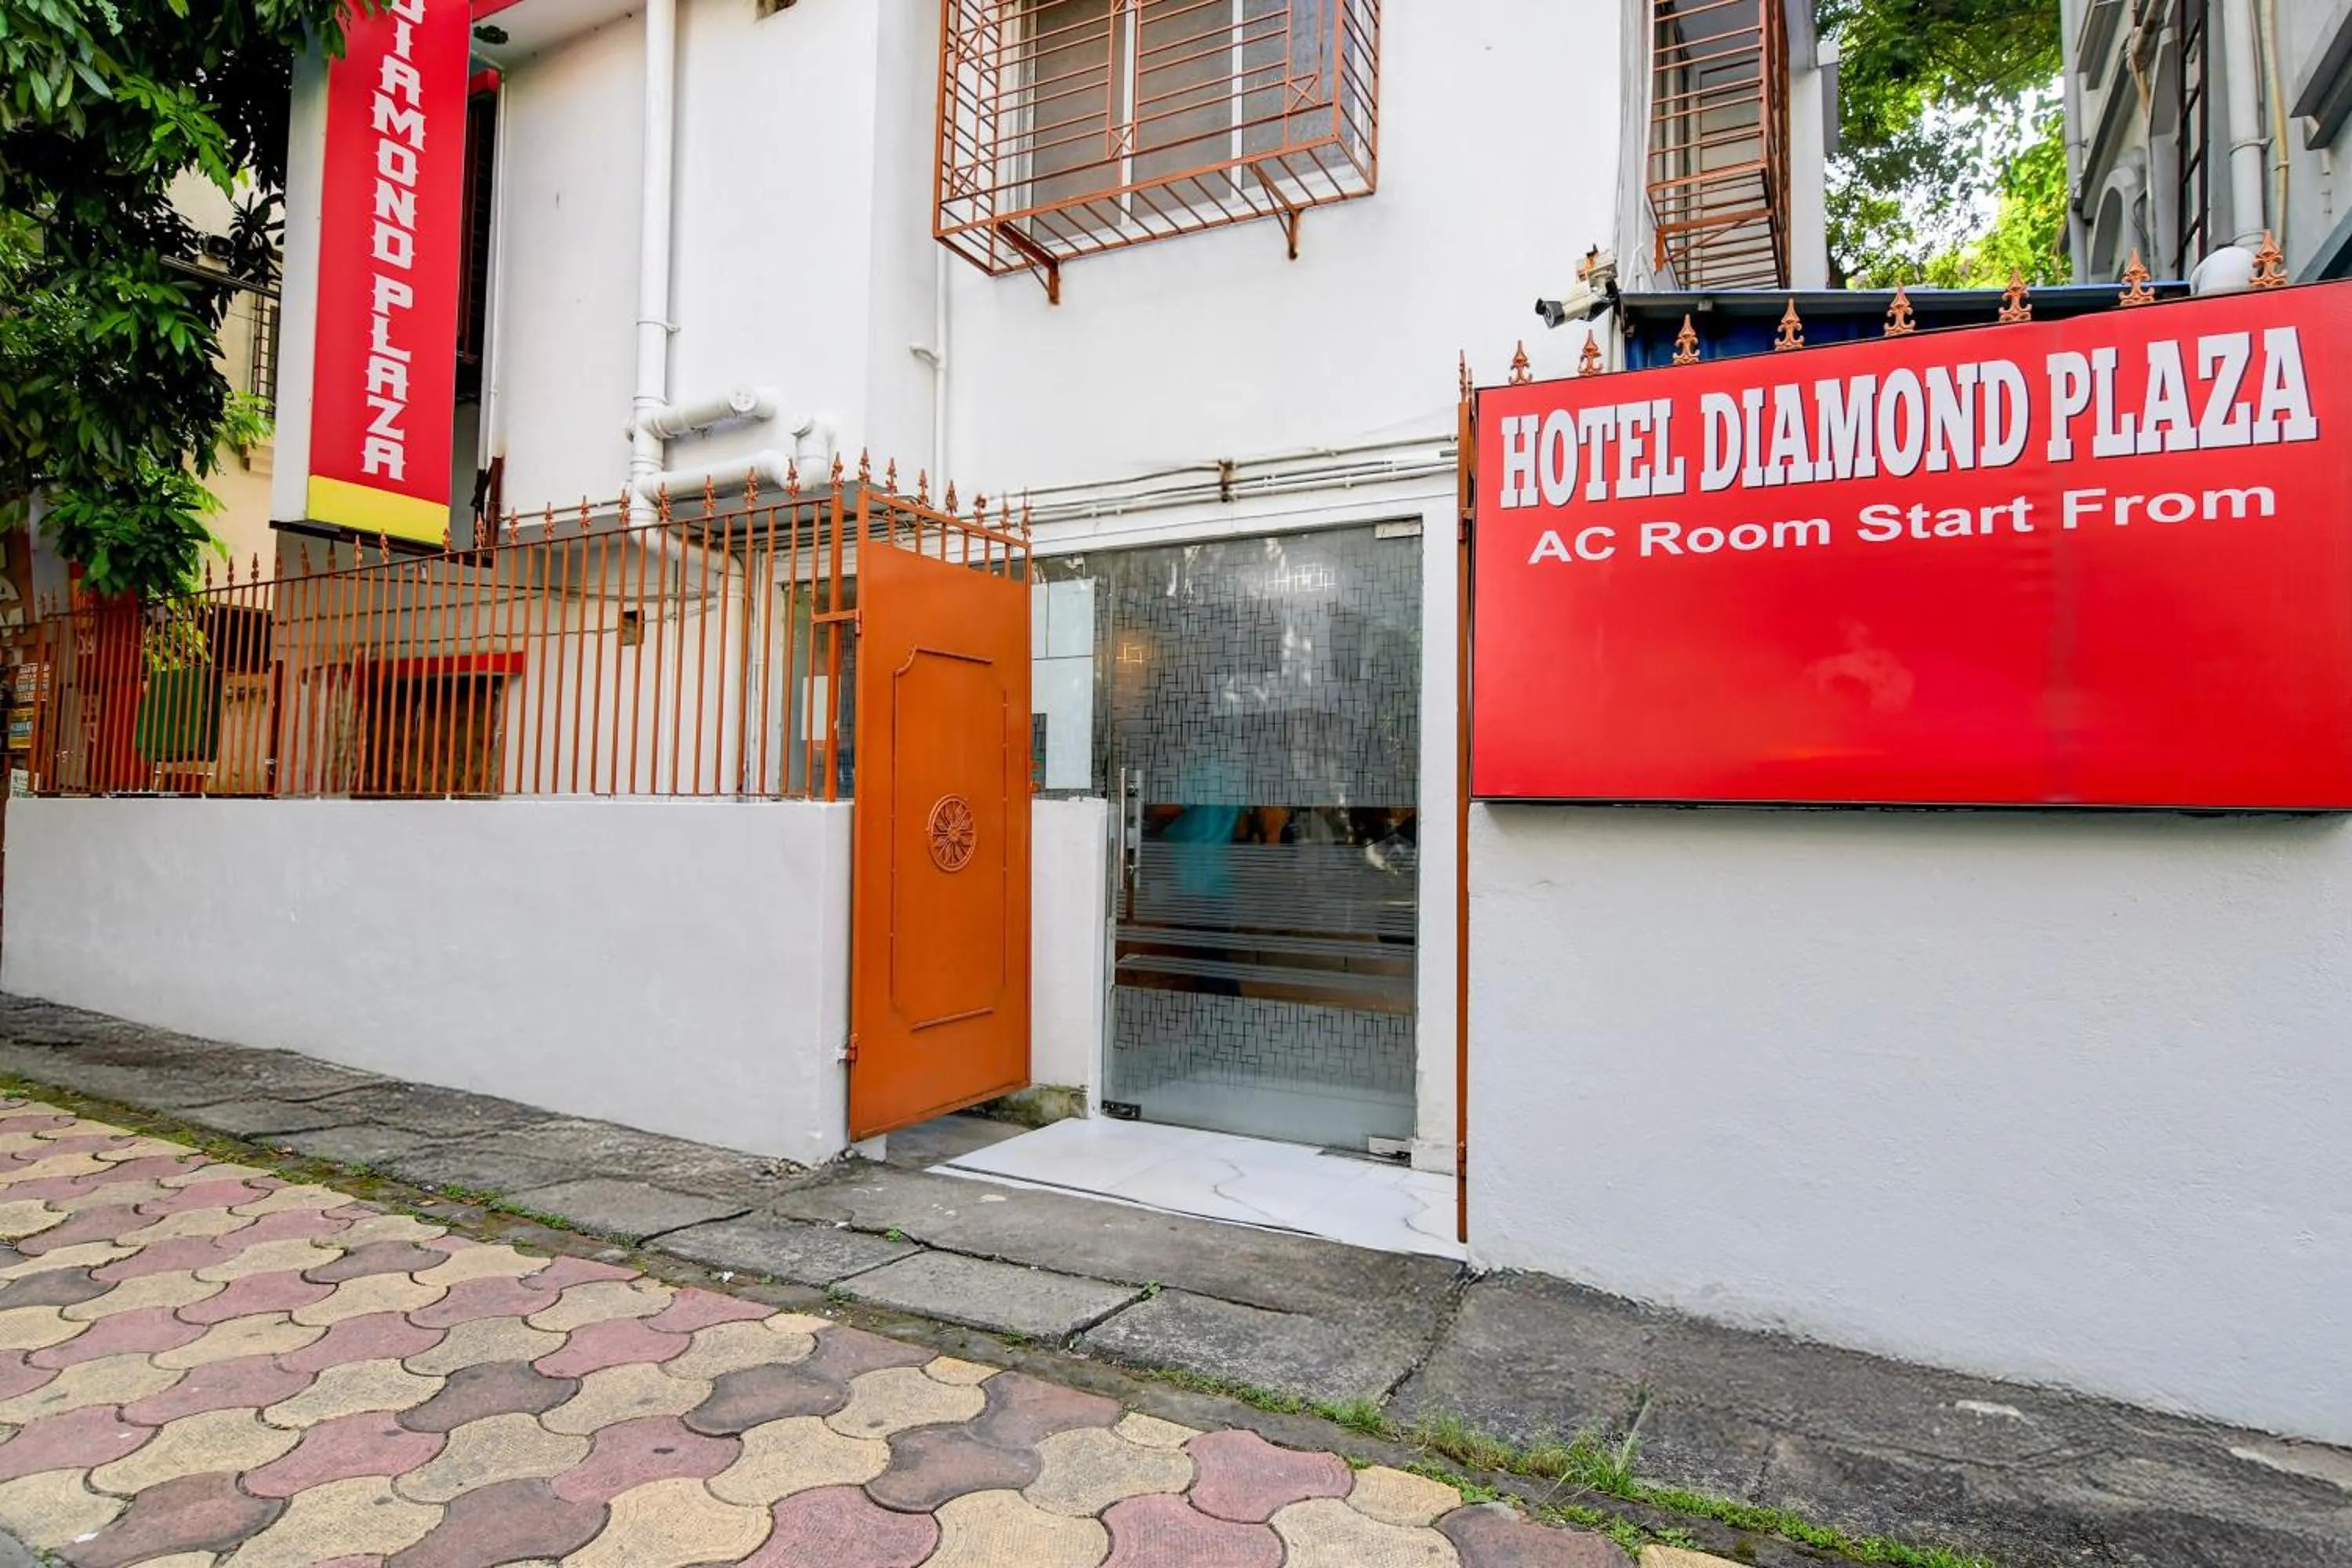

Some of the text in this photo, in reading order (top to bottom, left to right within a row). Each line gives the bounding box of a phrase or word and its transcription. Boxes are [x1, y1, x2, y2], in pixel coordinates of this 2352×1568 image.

[362, 273, 413, 481] PLAZA
[1500, 325, 2318, 510] HOTEL DIAMOND PLAZA
[1528, 486, 2275, 564] AC Room Start From
